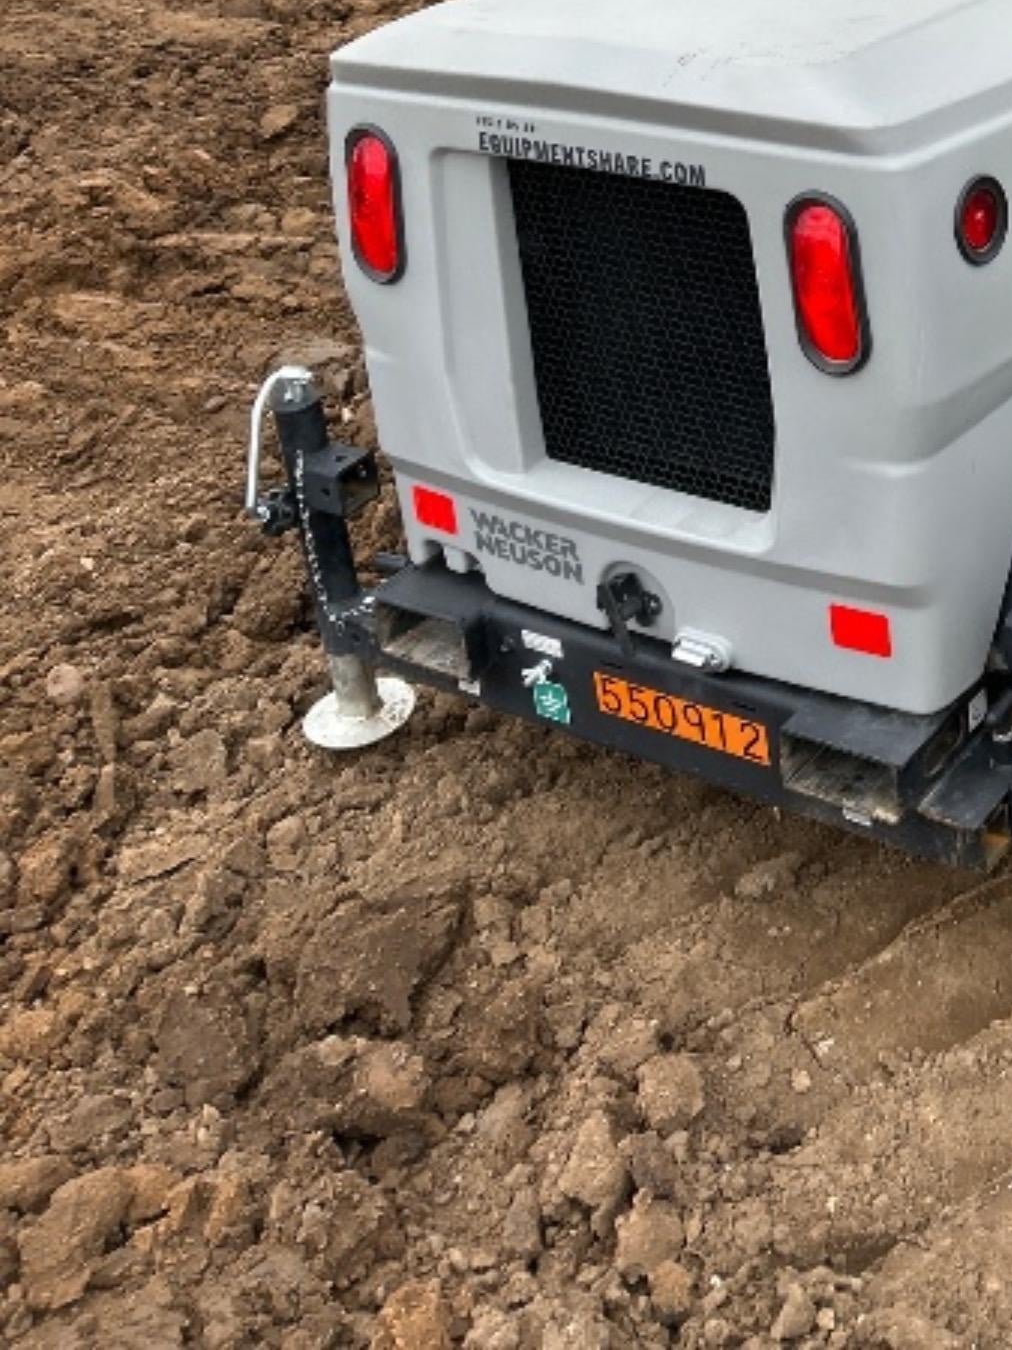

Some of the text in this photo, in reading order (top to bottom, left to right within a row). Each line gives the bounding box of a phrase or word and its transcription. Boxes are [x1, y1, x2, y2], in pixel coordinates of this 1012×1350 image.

[479, 131, 706, 187] EQUIPMENTSHARE.COM
[468, 507, 579, 562] WACKER
[475, 530, 585, 586] NEUSON
[601, 677, 764, 763] 550912
